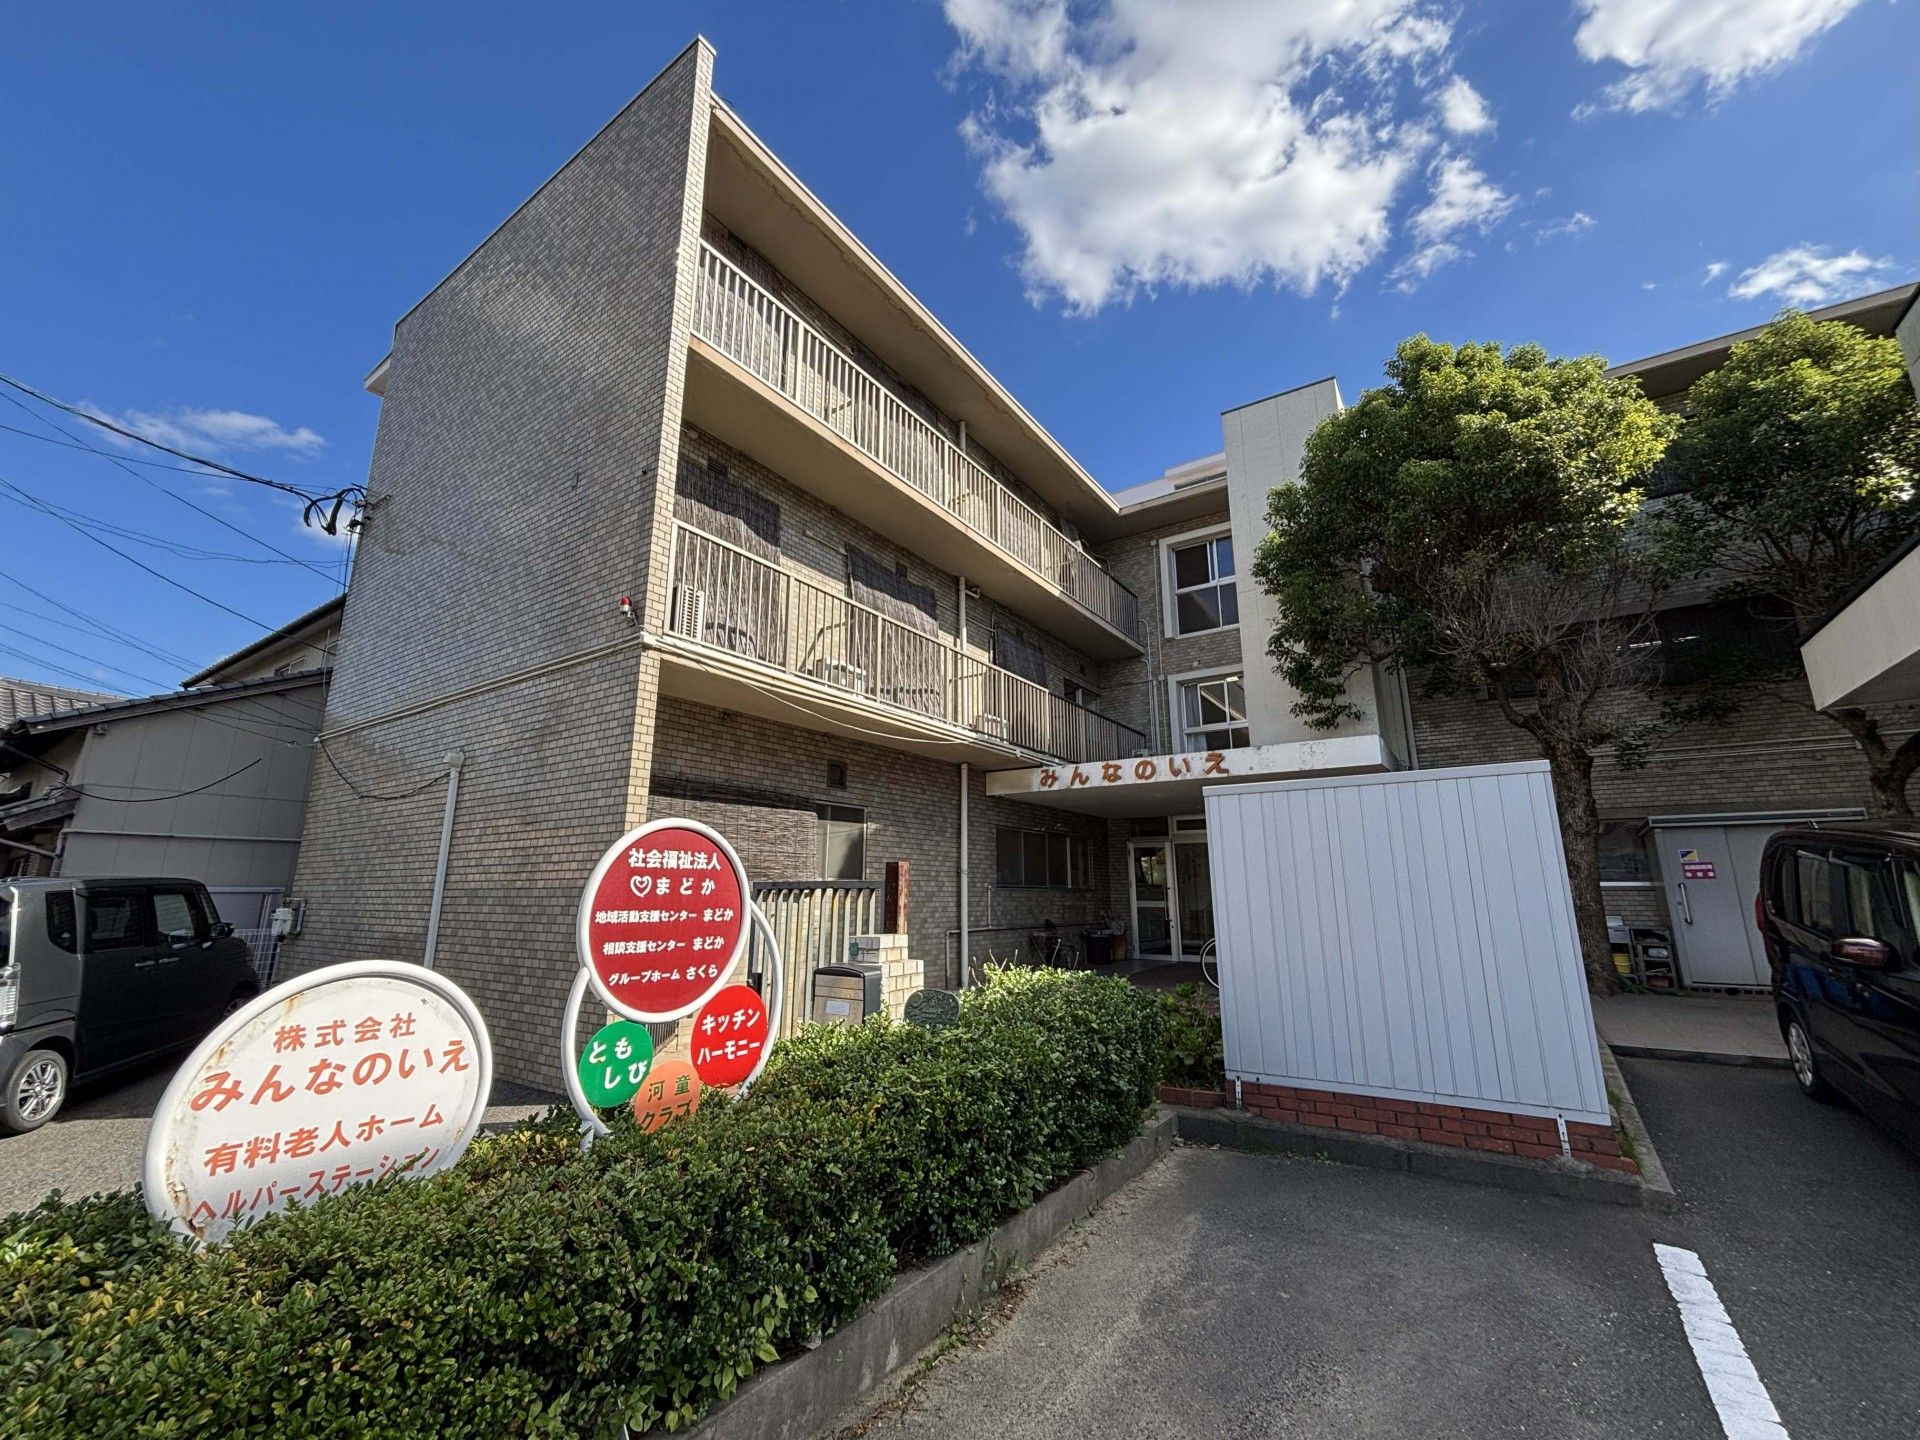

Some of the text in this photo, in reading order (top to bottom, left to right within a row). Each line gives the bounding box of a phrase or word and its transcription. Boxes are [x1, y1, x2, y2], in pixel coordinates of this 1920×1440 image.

[1040, 752, 1230, 788] みんなのいえ
[628, 848, 721, 870] 社会福祉法人
[656, 877, 715, 895] まどか
[595, 908, 734, 924] 地域活動支援センター まどか
[602, 936, 724, 956] 相談支援センター まどか
[608, 964, 718, 986] グループホーム さくら
[273, 1011, 416, 1054] 株式会社
[701, 1008, 760, 1036] キッチン
[589, 1037, 632, 1064] とも
[697, 1039, 760, 1065] ハーモニー
[190, 1039, 470, 1112] みんなのいえ
[604, 1060, 648, 1089] しび
[647, 1075, 691, 1102] 河童
[203, 1104, 444, 1177] 有料老人ホーム
